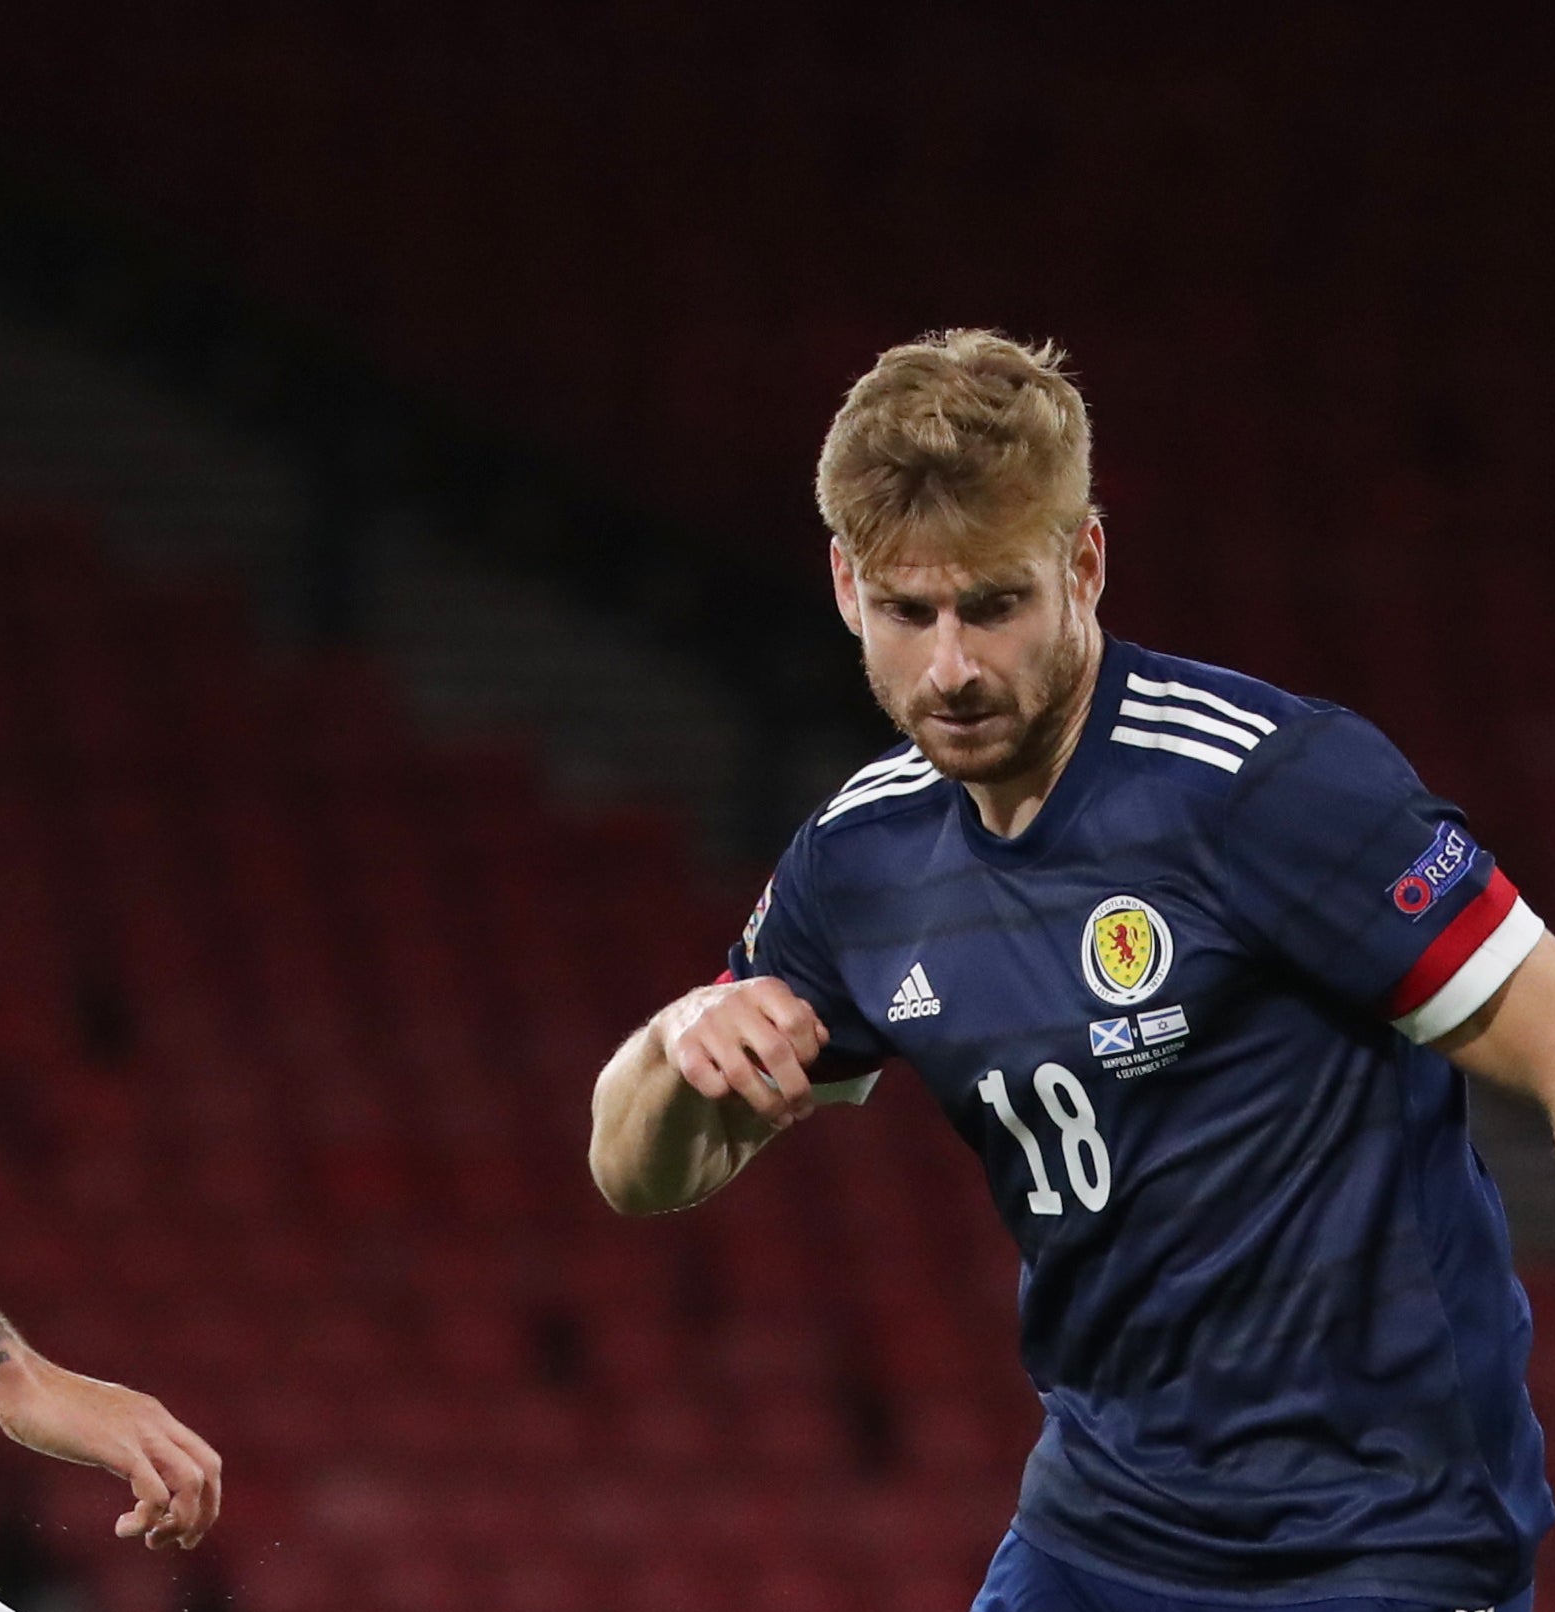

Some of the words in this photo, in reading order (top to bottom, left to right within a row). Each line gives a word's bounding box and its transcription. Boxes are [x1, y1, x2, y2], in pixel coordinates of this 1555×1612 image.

[1096, 899, 1138, 918] SCOTLAND
[887, 998, 941, 1022] adidas
[977, 1062, 1111, 1215] 18
